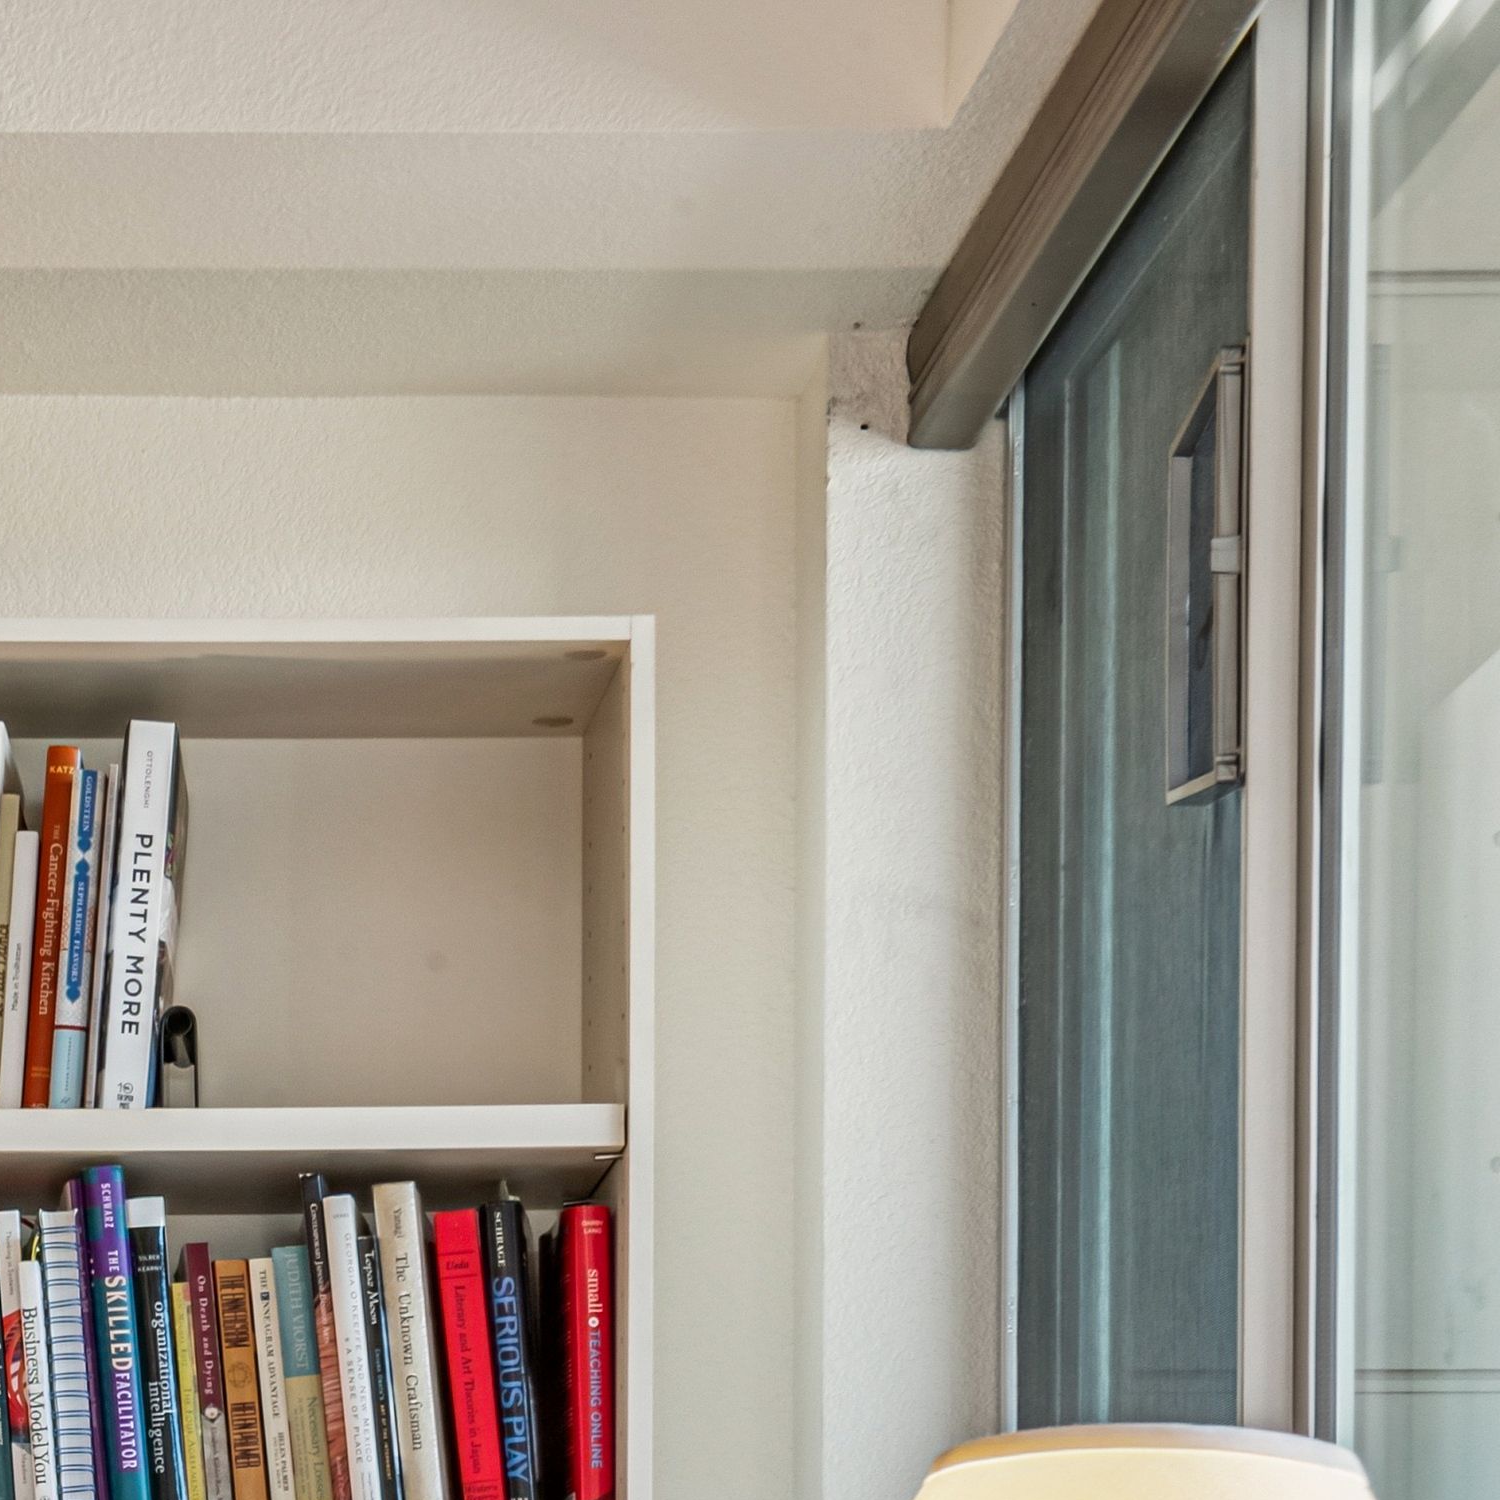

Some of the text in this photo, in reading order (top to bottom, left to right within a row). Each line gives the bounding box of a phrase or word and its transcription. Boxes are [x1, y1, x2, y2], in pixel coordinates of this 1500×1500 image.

[39, 961, 55, 1015] Kitchen
[40, 843, 63, 957] Cancer-Fighting
[121, 833, 153, 1035] PLENTY MORE
[22, 1308, 49, 1485] Business Model You
[101, 1183, 137, 1469] SCHWARZ THE SKILLED FACILITATOR
[151, 1302, 173, 1414] organizational
[393, 1208, 423, 1451] Yanagi The Unknown Craftsman
[492, 1277, 528, 1482] SERIOUS PLAY
[588, 1269, 602, 1468] small TEACHING ONLINE
[148, 1381, 166, 1474] intelligence
